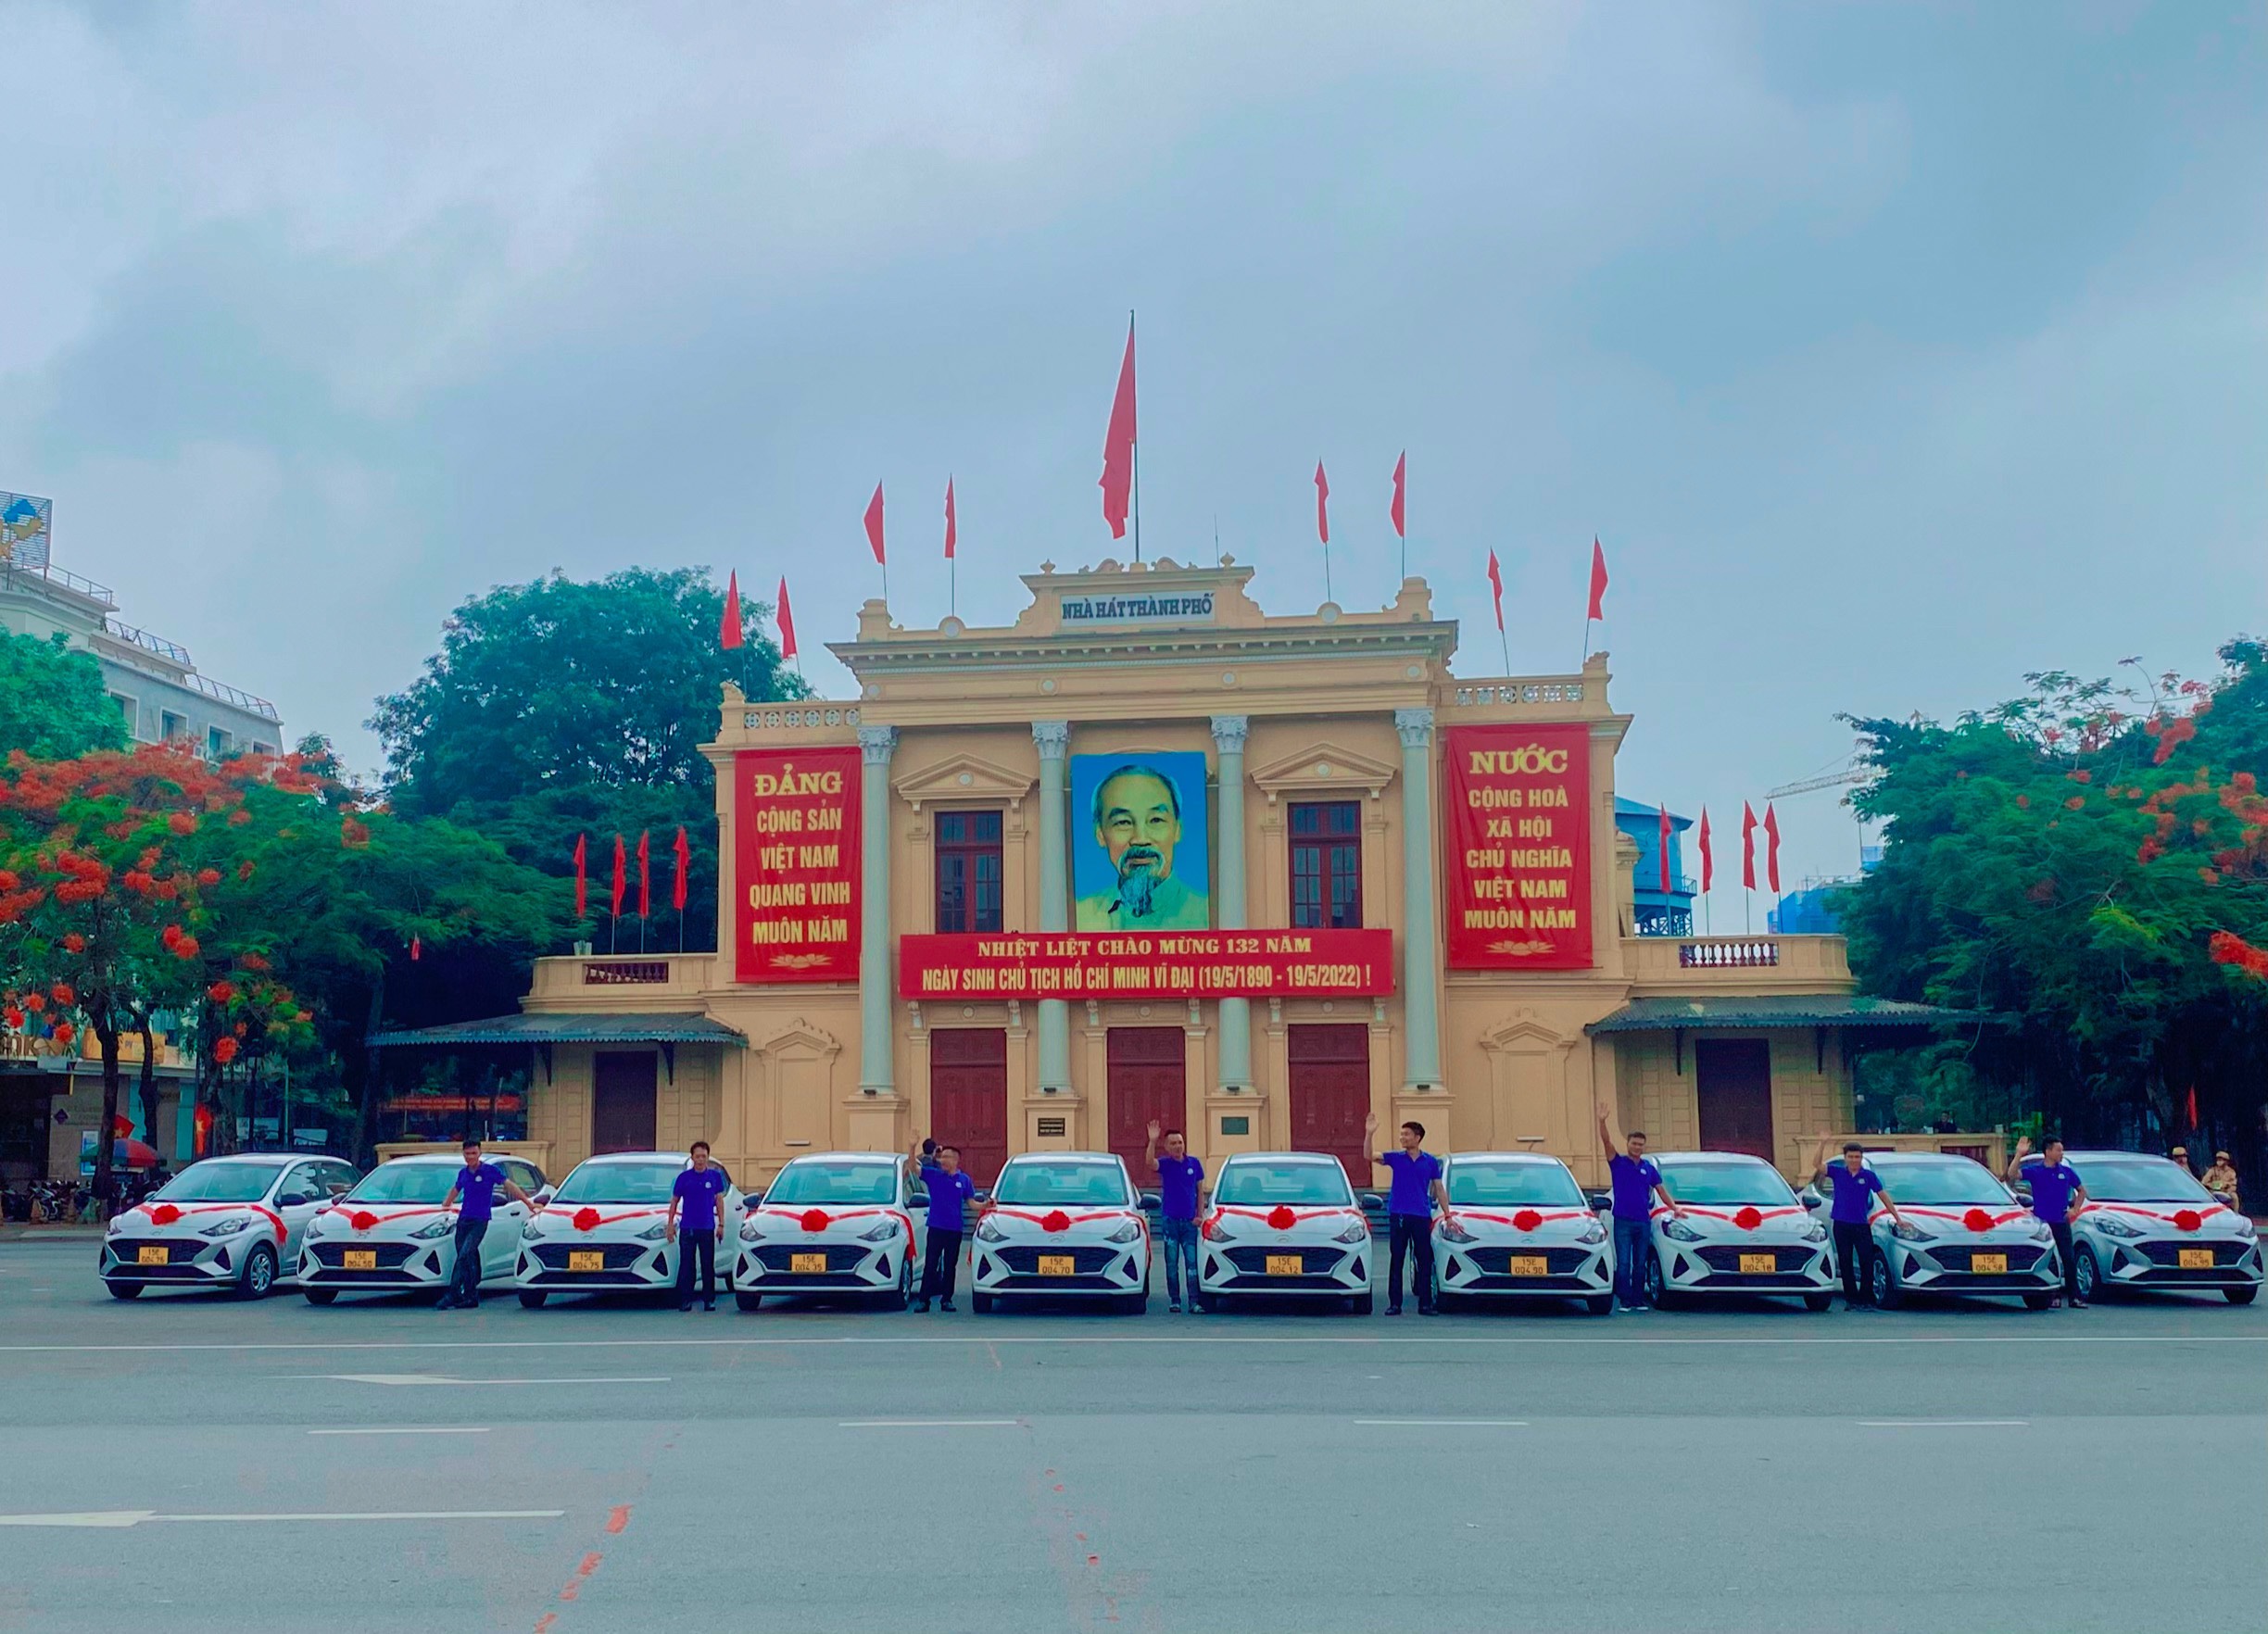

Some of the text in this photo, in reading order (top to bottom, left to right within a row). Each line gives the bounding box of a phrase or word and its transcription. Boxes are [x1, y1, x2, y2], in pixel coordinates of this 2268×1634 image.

[1062, 592, 1215, 619] NHÀ HÁT THÀNH PHỐ
[1468, 742, 1568, 774] NƯỚC
[754, 762, 843, 797] ĐẢNG
[1468, 786, 1522, 811] CỘNG
[757, 798, 842, 837] CỘNG SẢN
[1487, 815, 1552, 841] XÃ HỘI
[761, 842, 839, 874] VIỆT NAM
[1467, 842, 1572, 868] CHỦ NGHĨA
[750, 882, 850, 910] QUANG VINH
[1474, 875, 1568, 902] VIỆT NAM
[752, 915, 848, 944] MUÔN NĂM
[1464, 906, 1576, 929] MUÔN NĂM
[977, 936, 1311, 959] NHIỆT LIỆT CHÀO MỪNG 132 NĂM
[922, 964, 958, 990] NGÀY
[963, 968, 995, 990] SINH
[999, 961, 1026, 990] CHỦ
[1029, 967, 1060, 995] TỊCH
[1064, 960, 1082, 989] HỒ
[1086, 962, 1109, 989] CHÍ
[1113, 966, 1150, 988] MINH
[1153, 962, 1167, 988] VĨ
[1170, 966, 1194, 994] ĐẠI
[1198, 964, 1272, 990] (19/5/1890
[1286, 964, 1361, 988] 19/5/2022)
